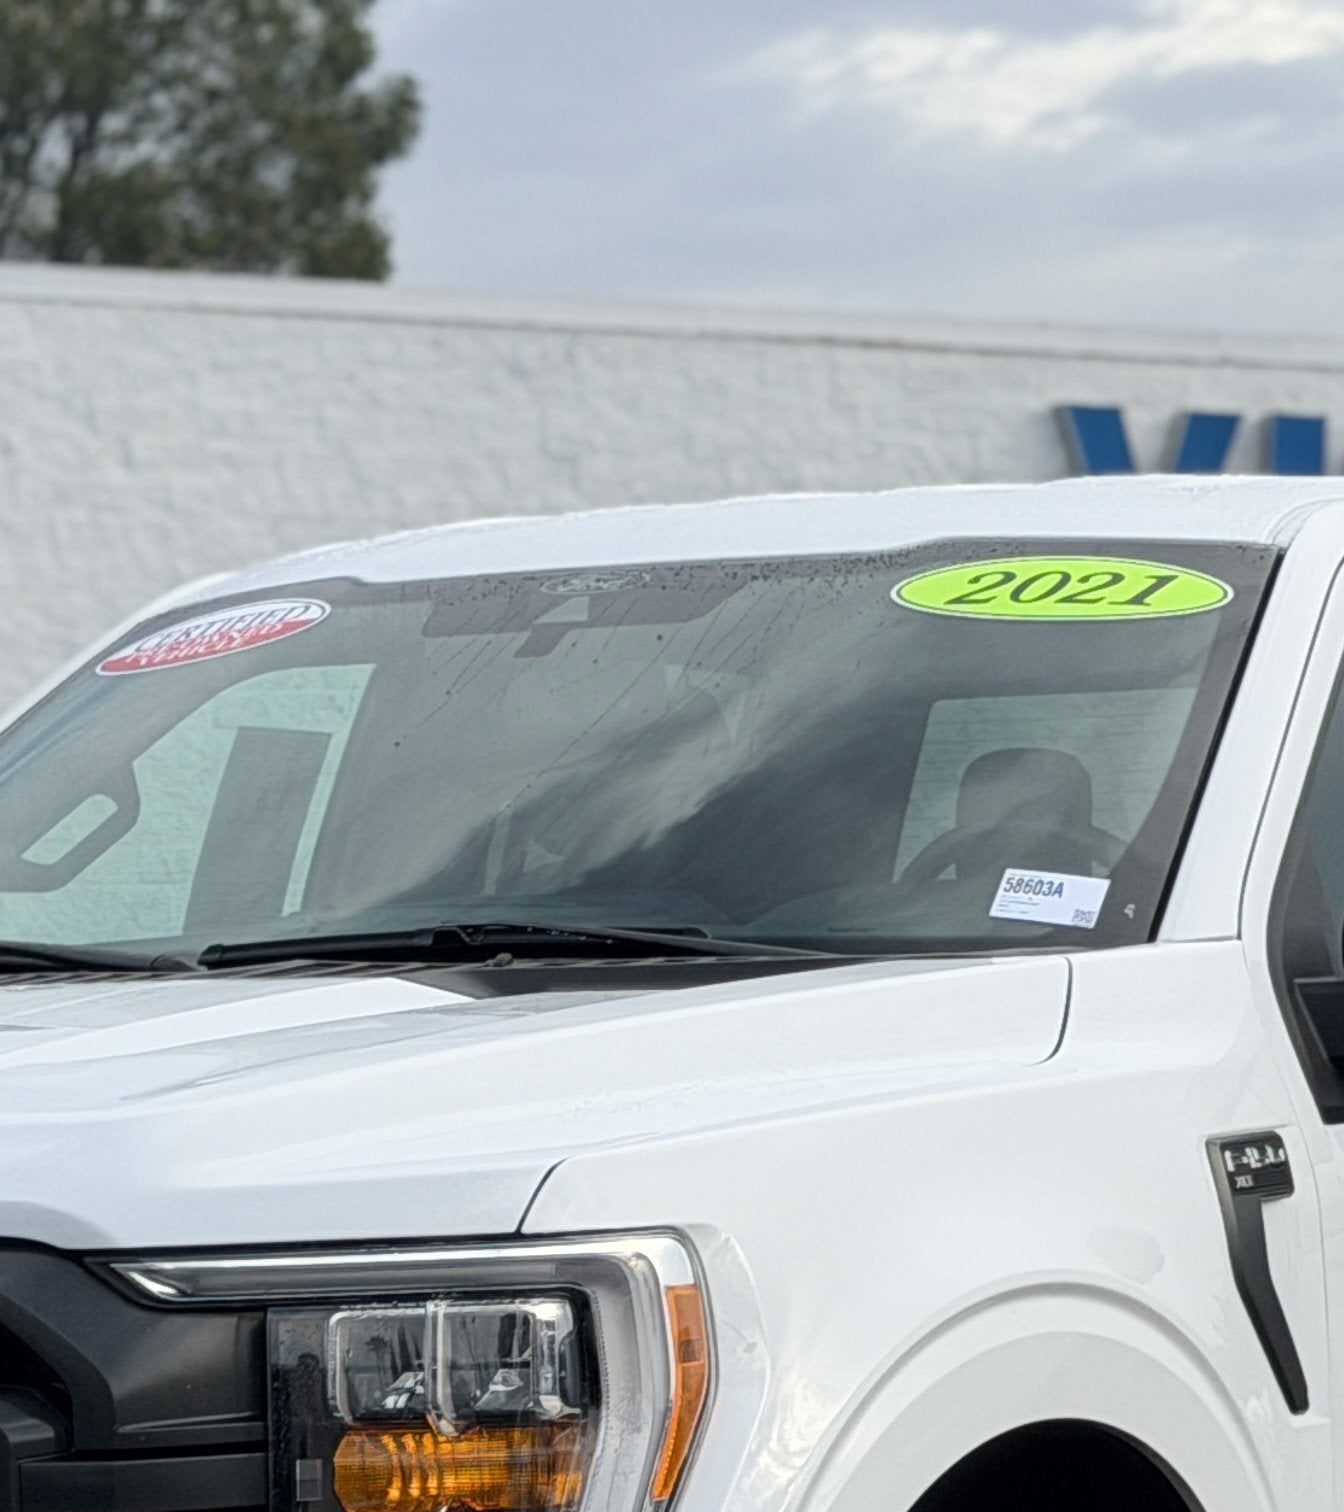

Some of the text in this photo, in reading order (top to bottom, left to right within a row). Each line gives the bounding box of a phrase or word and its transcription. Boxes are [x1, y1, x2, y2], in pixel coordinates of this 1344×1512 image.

[944, 571, 1178, 606] 2021
[134, 605, 312, 652] CERTIFIED
[1003, 877, 1064, 898] 58603A
